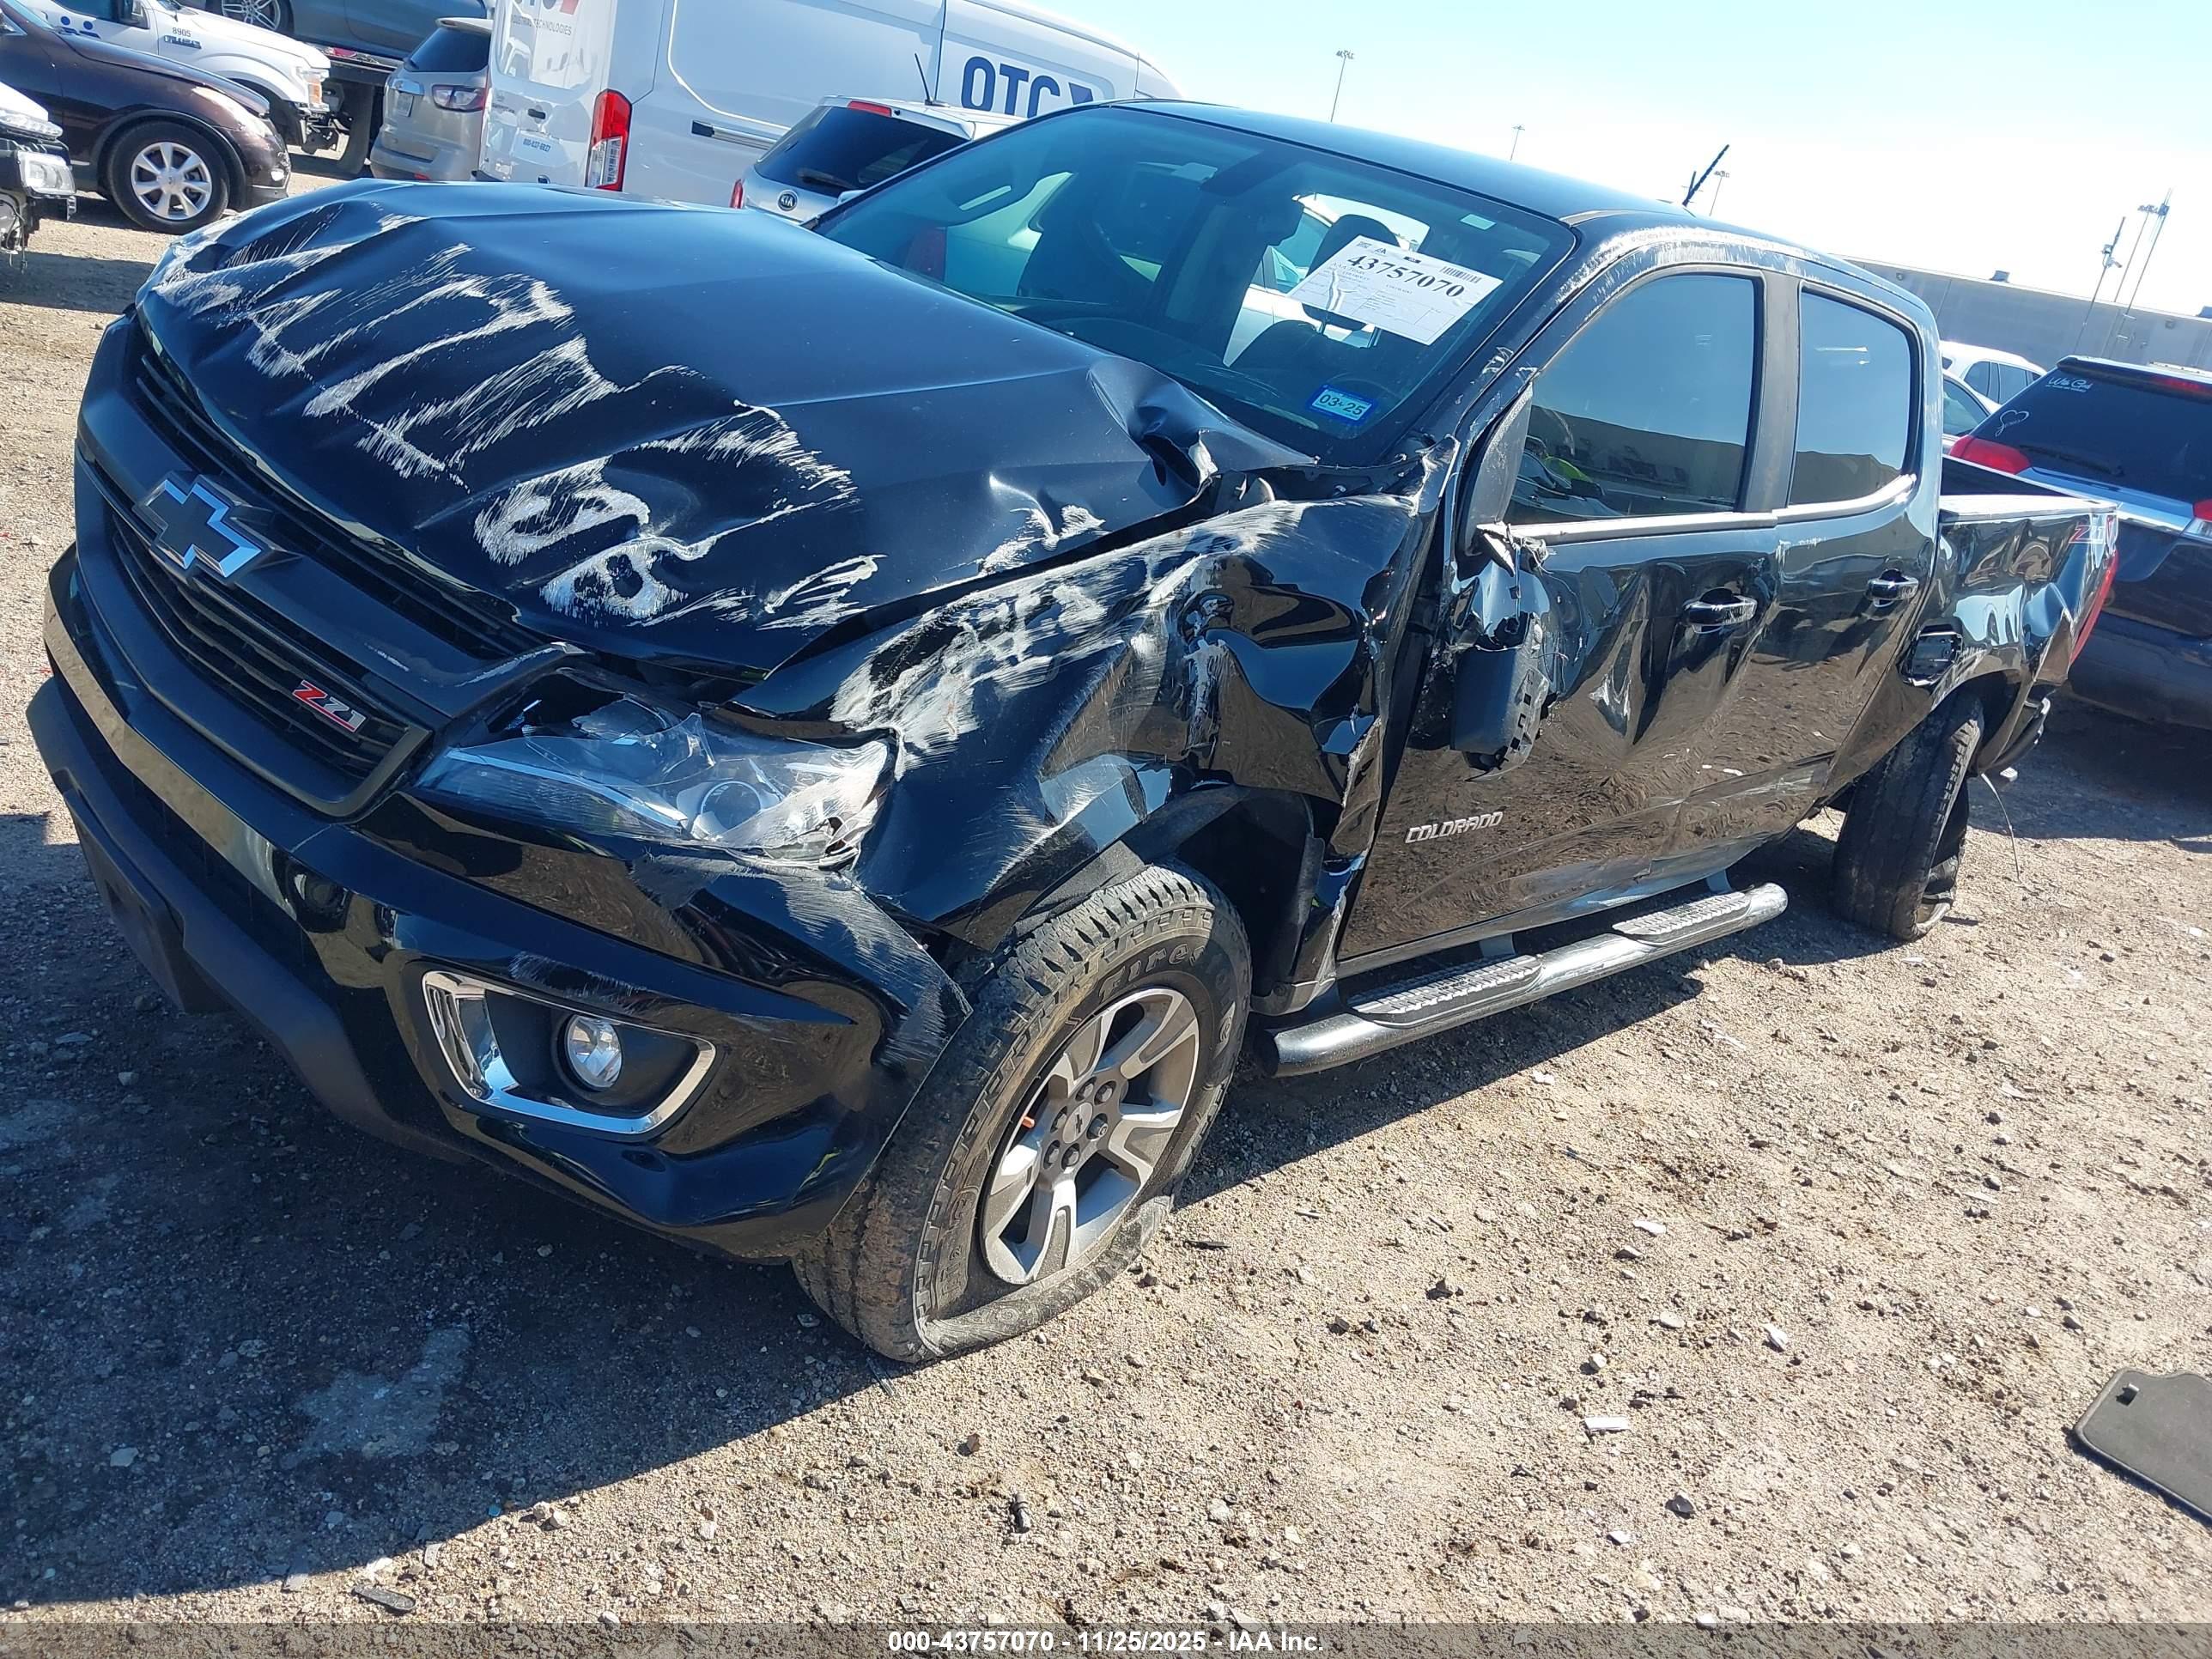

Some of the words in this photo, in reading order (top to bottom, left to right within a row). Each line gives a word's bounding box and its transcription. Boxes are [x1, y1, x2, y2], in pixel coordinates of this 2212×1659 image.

[172, 27, 191, 37] 8905
[1347, 255, 1465, 297] 43757070
[292, 679, 366, 732] Z71
[1404, 811, 1504, 844] COLORADO
